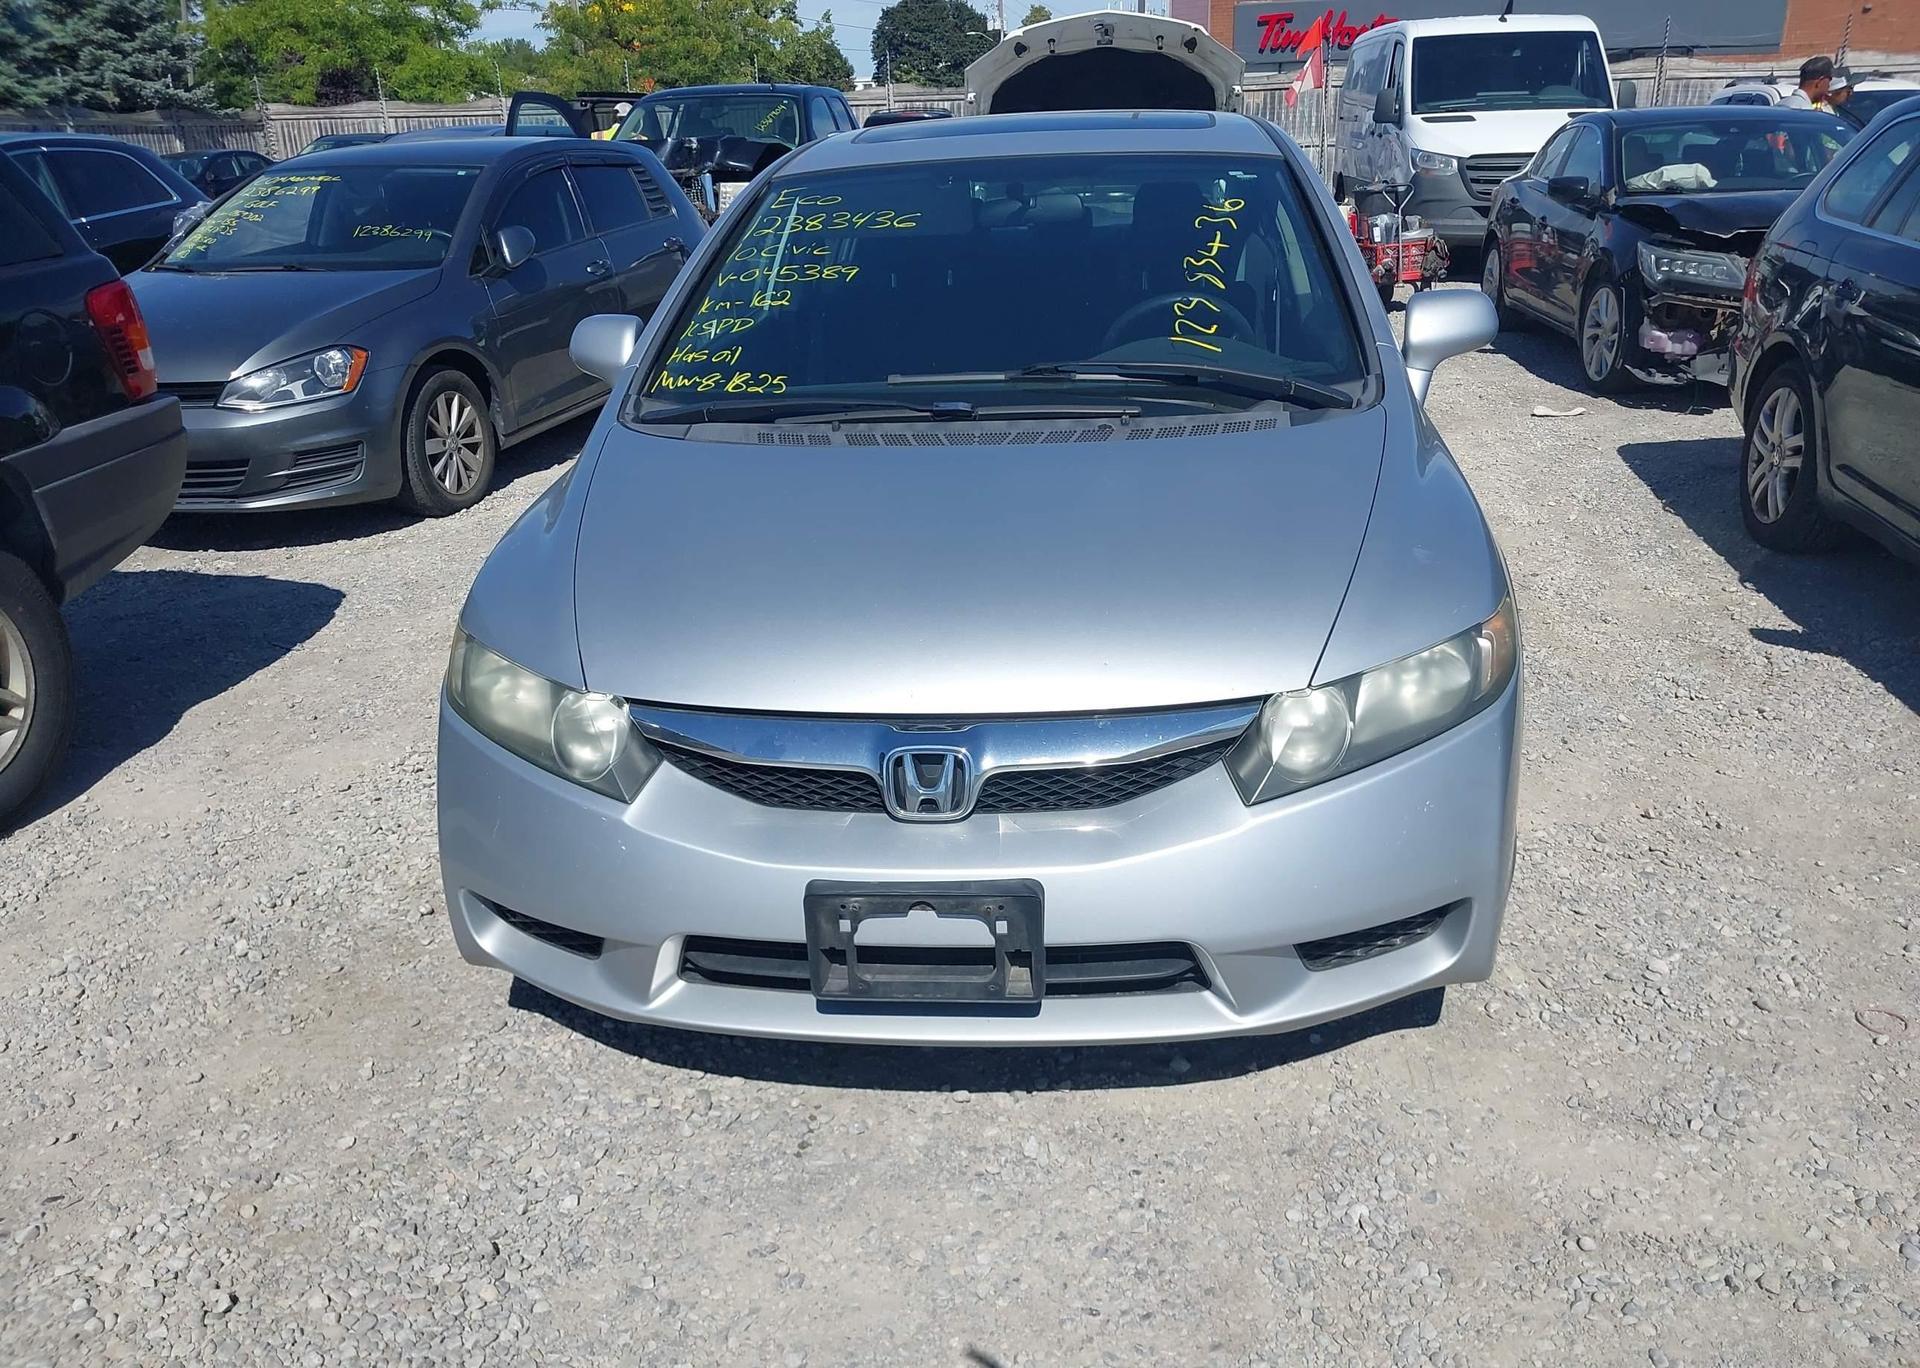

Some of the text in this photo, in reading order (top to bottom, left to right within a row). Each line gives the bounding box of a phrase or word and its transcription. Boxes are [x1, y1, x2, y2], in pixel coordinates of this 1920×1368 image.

[1257, 12, 1309, 54] Tim
[352, 224, 433, 243] 12386299
[744, 211, 922, 240] 12383436
